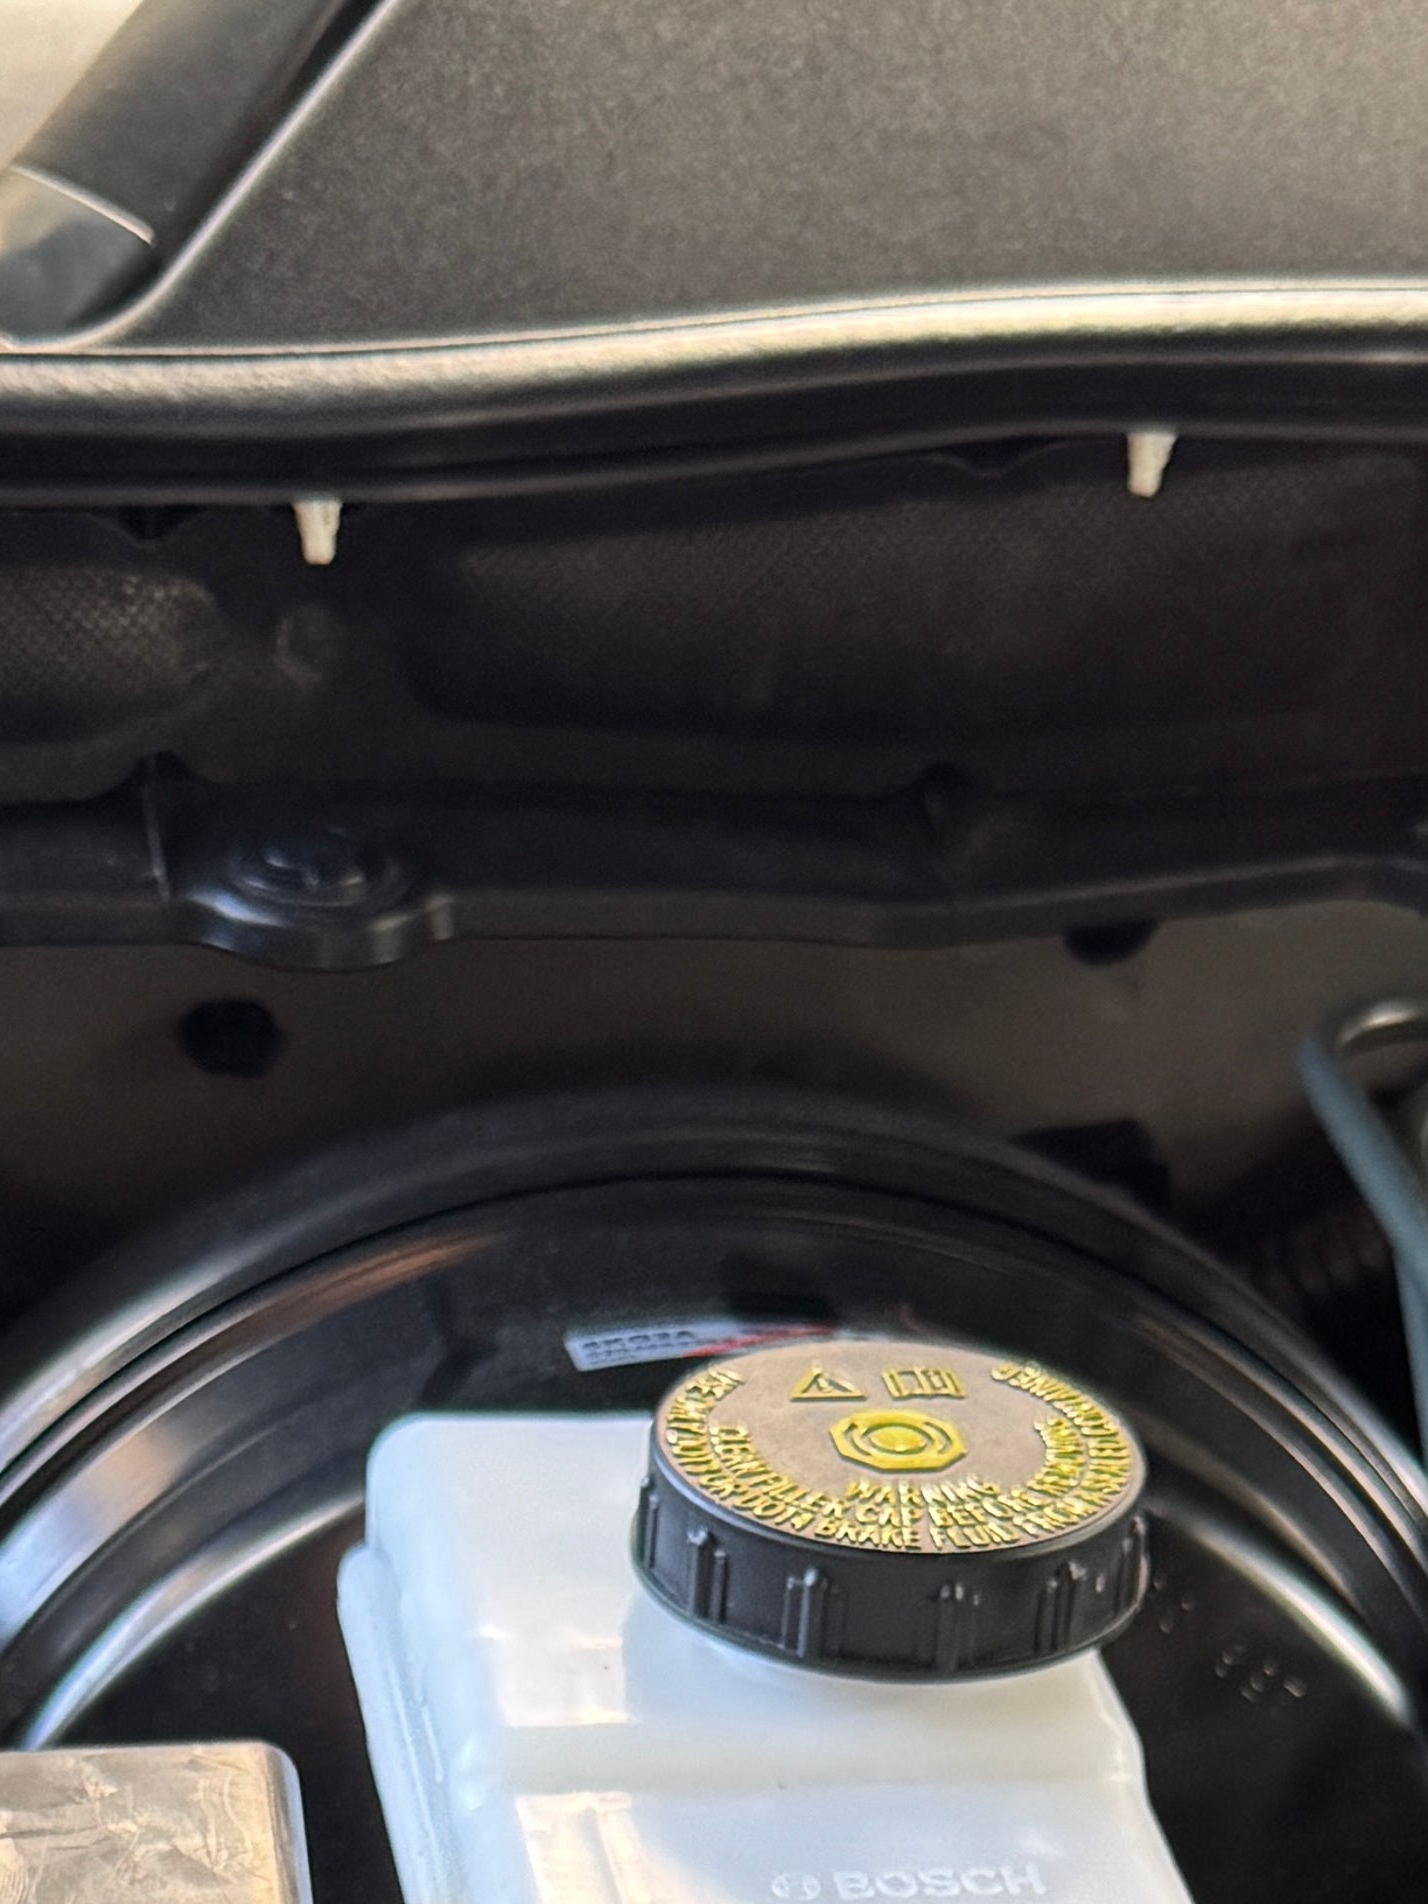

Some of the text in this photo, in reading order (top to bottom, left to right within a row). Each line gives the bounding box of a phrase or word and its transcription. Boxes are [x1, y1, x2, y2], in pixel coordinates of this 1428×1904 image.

[709, 1423, 772, 1482] CLEAN
[748, 1472, 848, 1521] FILLER
[855, 1502, 921, 1528] CAP
[928, 1488, 1049, 1528] BEFORE
[845, 1475, 999, 1505] WARNING
[814, 1516, 923, 1549] BRAKE
[929, 1521, 1021, 1550] FLUID
[832, 1862, 1047, 1901] BOSCH
